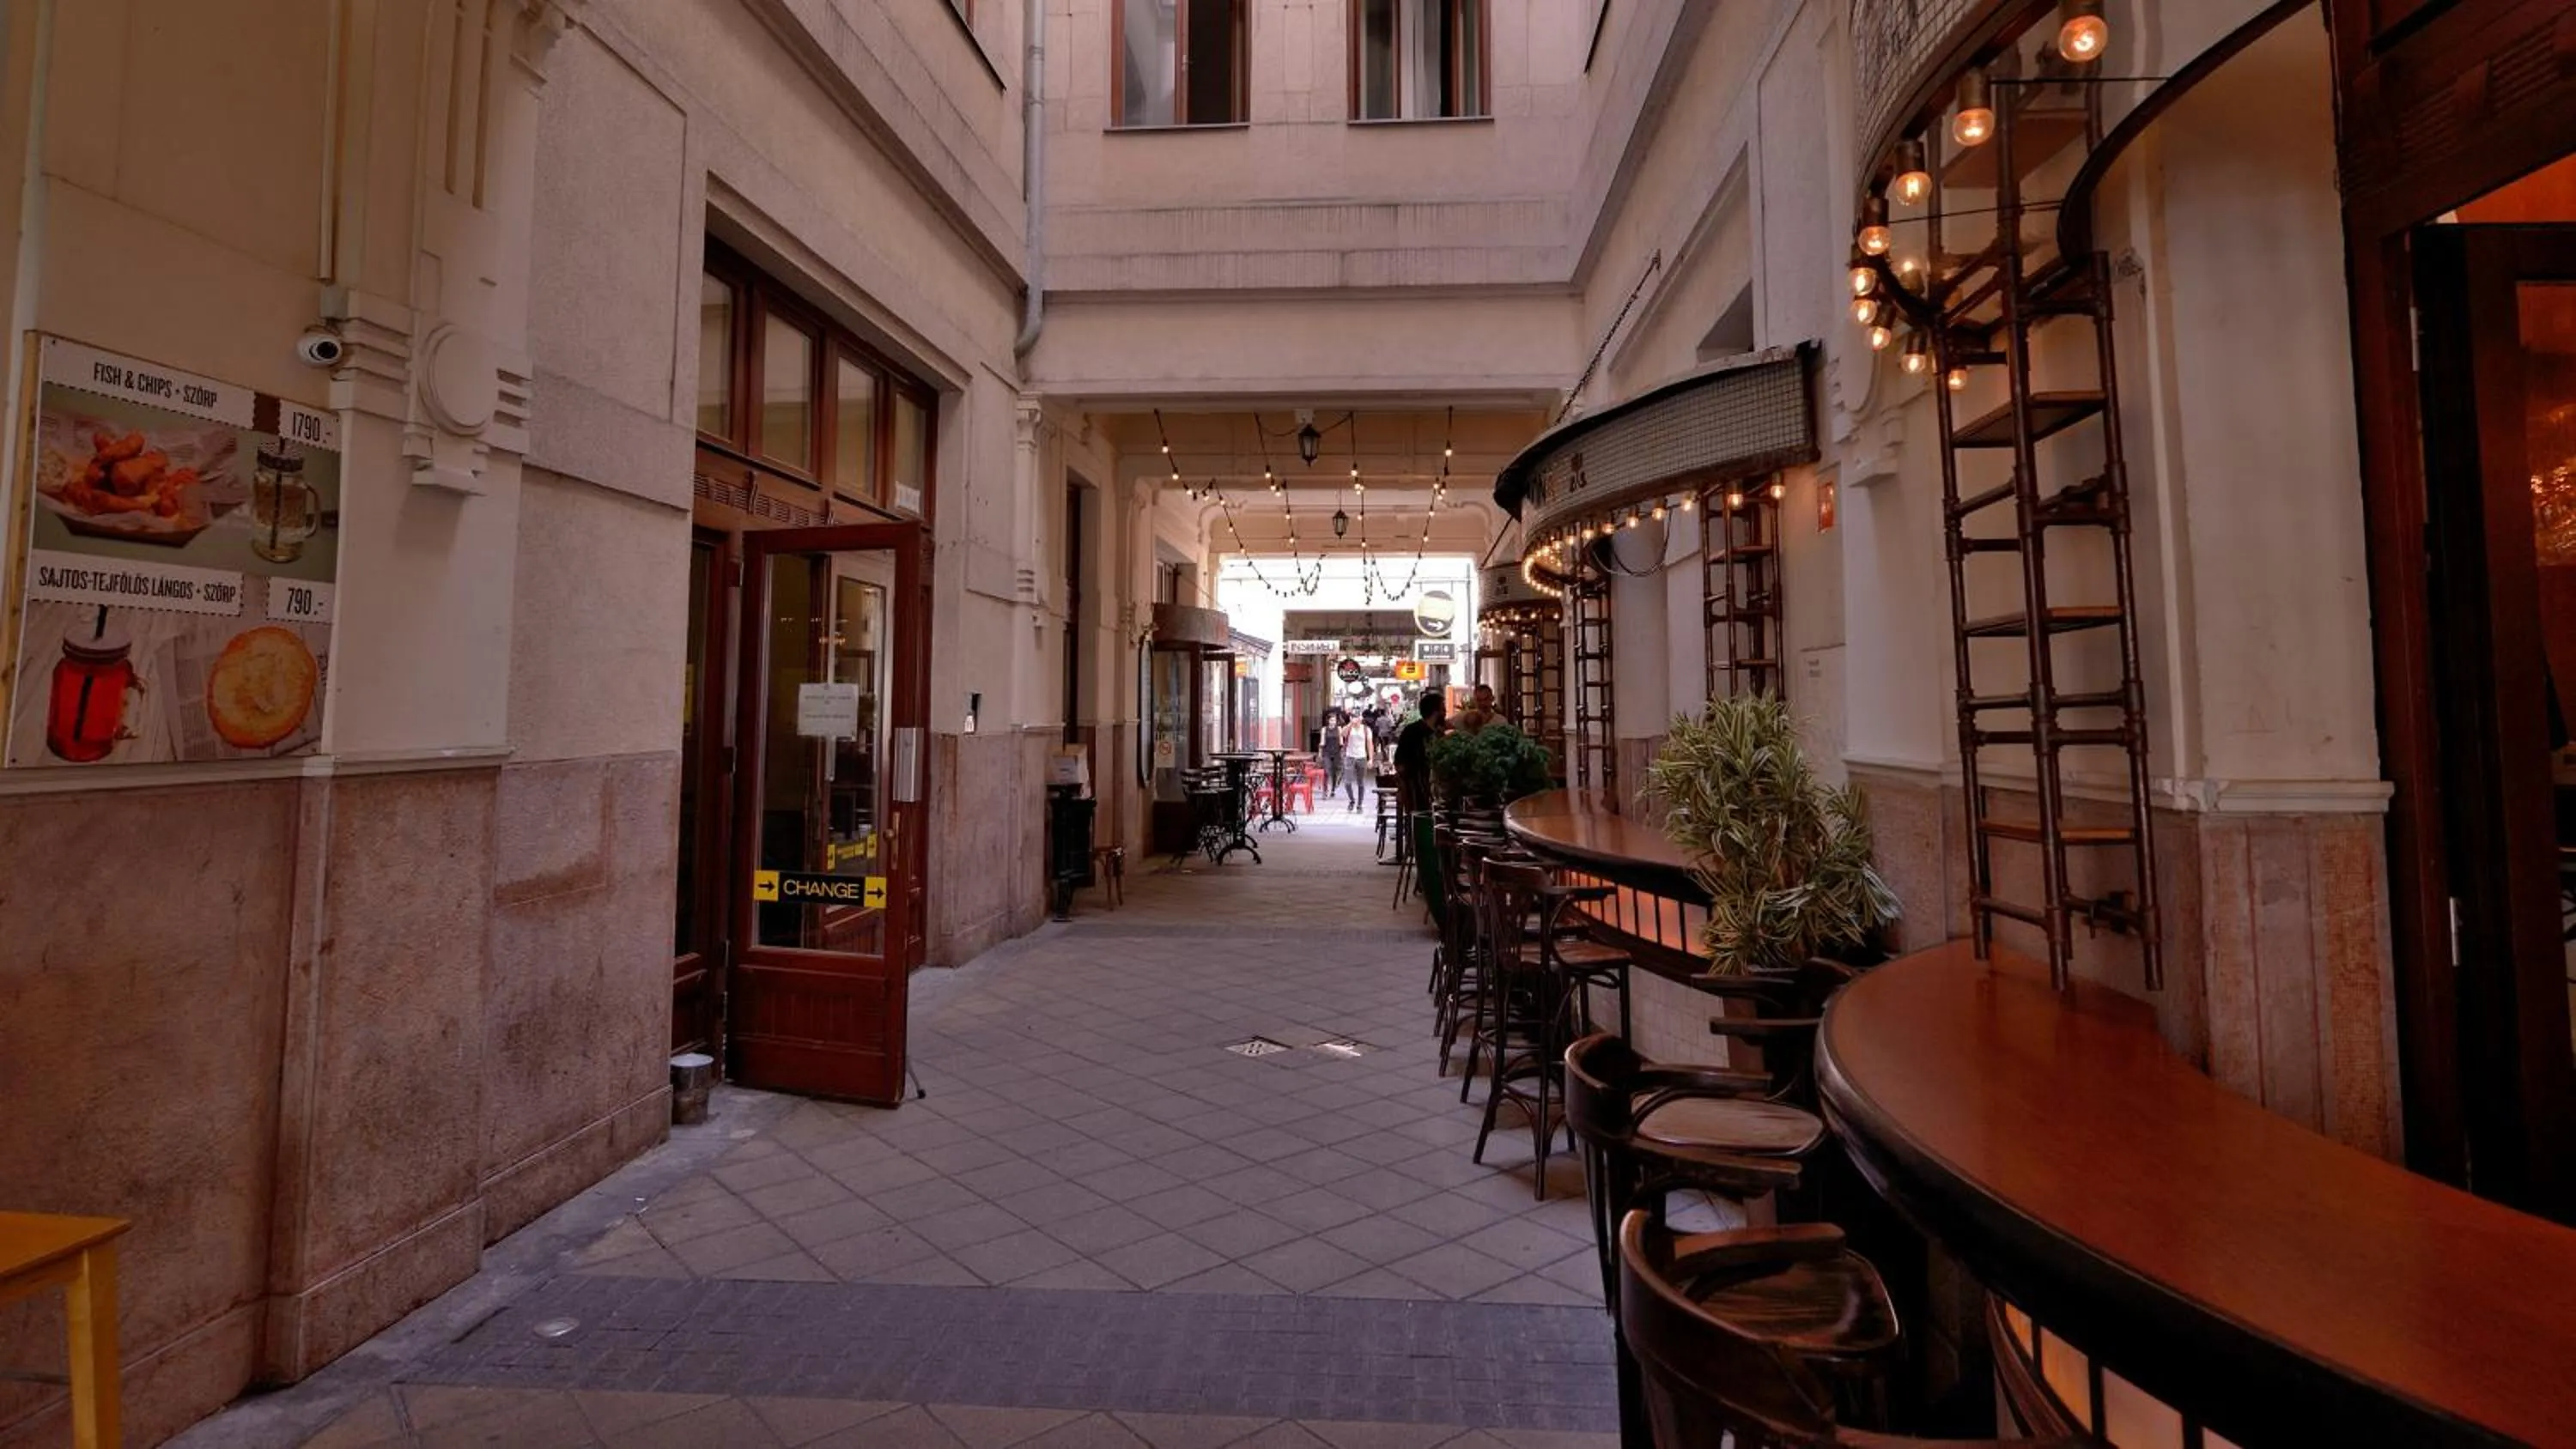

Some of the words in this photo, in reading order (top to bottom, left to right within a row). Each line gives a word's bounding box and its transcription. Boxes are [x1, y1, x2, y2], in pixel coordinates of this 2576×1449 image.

[94, 361, 121, 385] FISH
[125, 370, 134, 390] &
[137, 373, 172, 398] CHIPS
[151, 574, 193, 599] LÁNGOS
[782, 878, 860, 899] CHANGE
